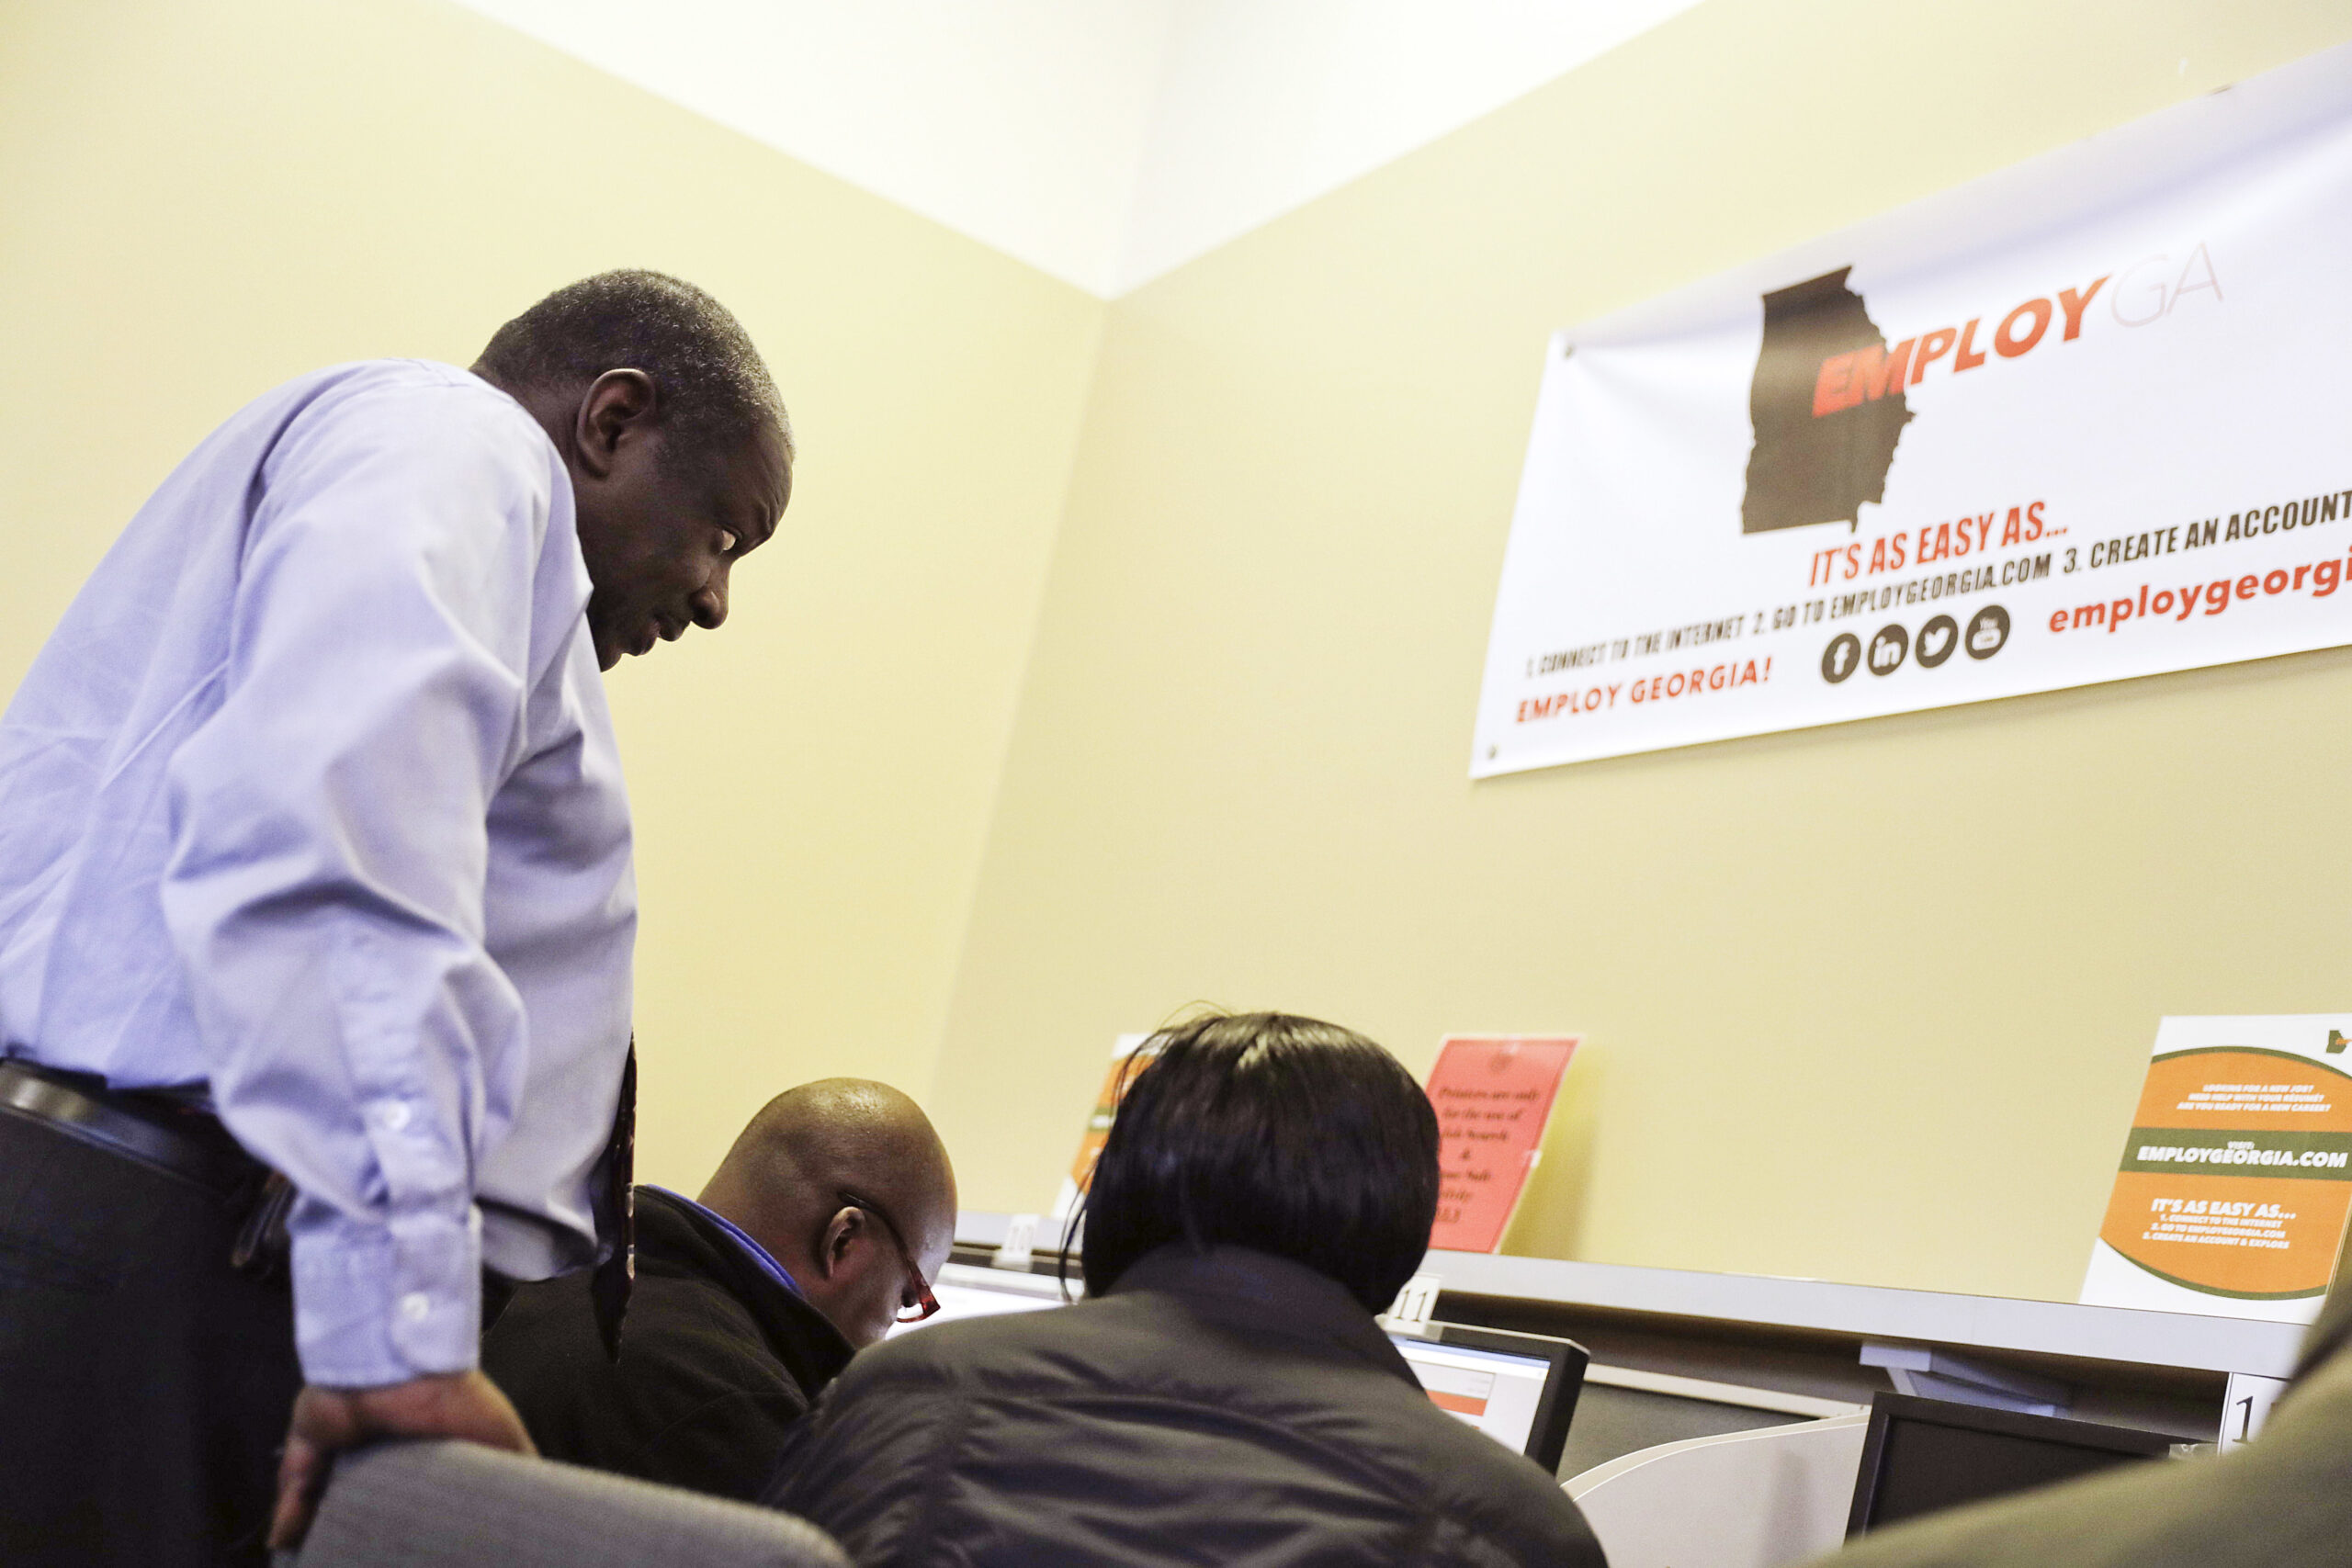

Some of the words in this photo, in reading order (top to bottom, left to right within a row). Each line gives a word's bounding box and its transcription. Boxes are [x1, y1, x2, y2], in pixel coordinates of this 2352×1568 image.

[1810, 543, 1861, 587] IT'S
[1869, 533, 1907, 575] AS
[1916, 511, 1998, 565] EASY
[2001, 501, 2068, 548] AS...
[1539, 643, 1607, 675] CONNECT
[1611, 637, 1630, 661] TO
[1634, 630, 1663, 655] THE
[1666, 614, 1745, 650] INTERNET
[1753, 611, 1765, 636] 2.
[1772, 605, 1796, 630] GO
[1803, 599, 1824, 624] TO
[1830, 553, 2052, 620] EMPLOYGEORGIA.COM
[2063, 547, 2082, 576] 3.
[2090, 525, 2179, 570] CREATE
[2184, 517, 2220, 551] AN
[2224, 490, 2352, 543] ACCOUNT
[1516, 682, 1622, 724] EMPLOY
[1631, 656, 1772, 704] GEORGIA!
[2136, 1146, 2348, 1168] EMPLOYGEORGIA.COM
[2151, 1198, 2184, 1213] IT'S
[2183, 1200, 2208, 1214] AS
[2209, 1201, 2256, 1217] EASY
[2255, 1203, 2296, 1219] AS...
[2168, 1214, 2211, 1224] CONNECT
[2211, 1216, 2222, 1224] TO
[2222, 1216, 2239, 1226] THE
[2239, 1218, 2283, 1229] INTERNET
[2187, 1224, 2286, 1239] EMPLOYGEORGIA.COM
[2198, 1235, 2240, 1247] ACCOUNT
[1394, 1288, 1429, 1323] 11
